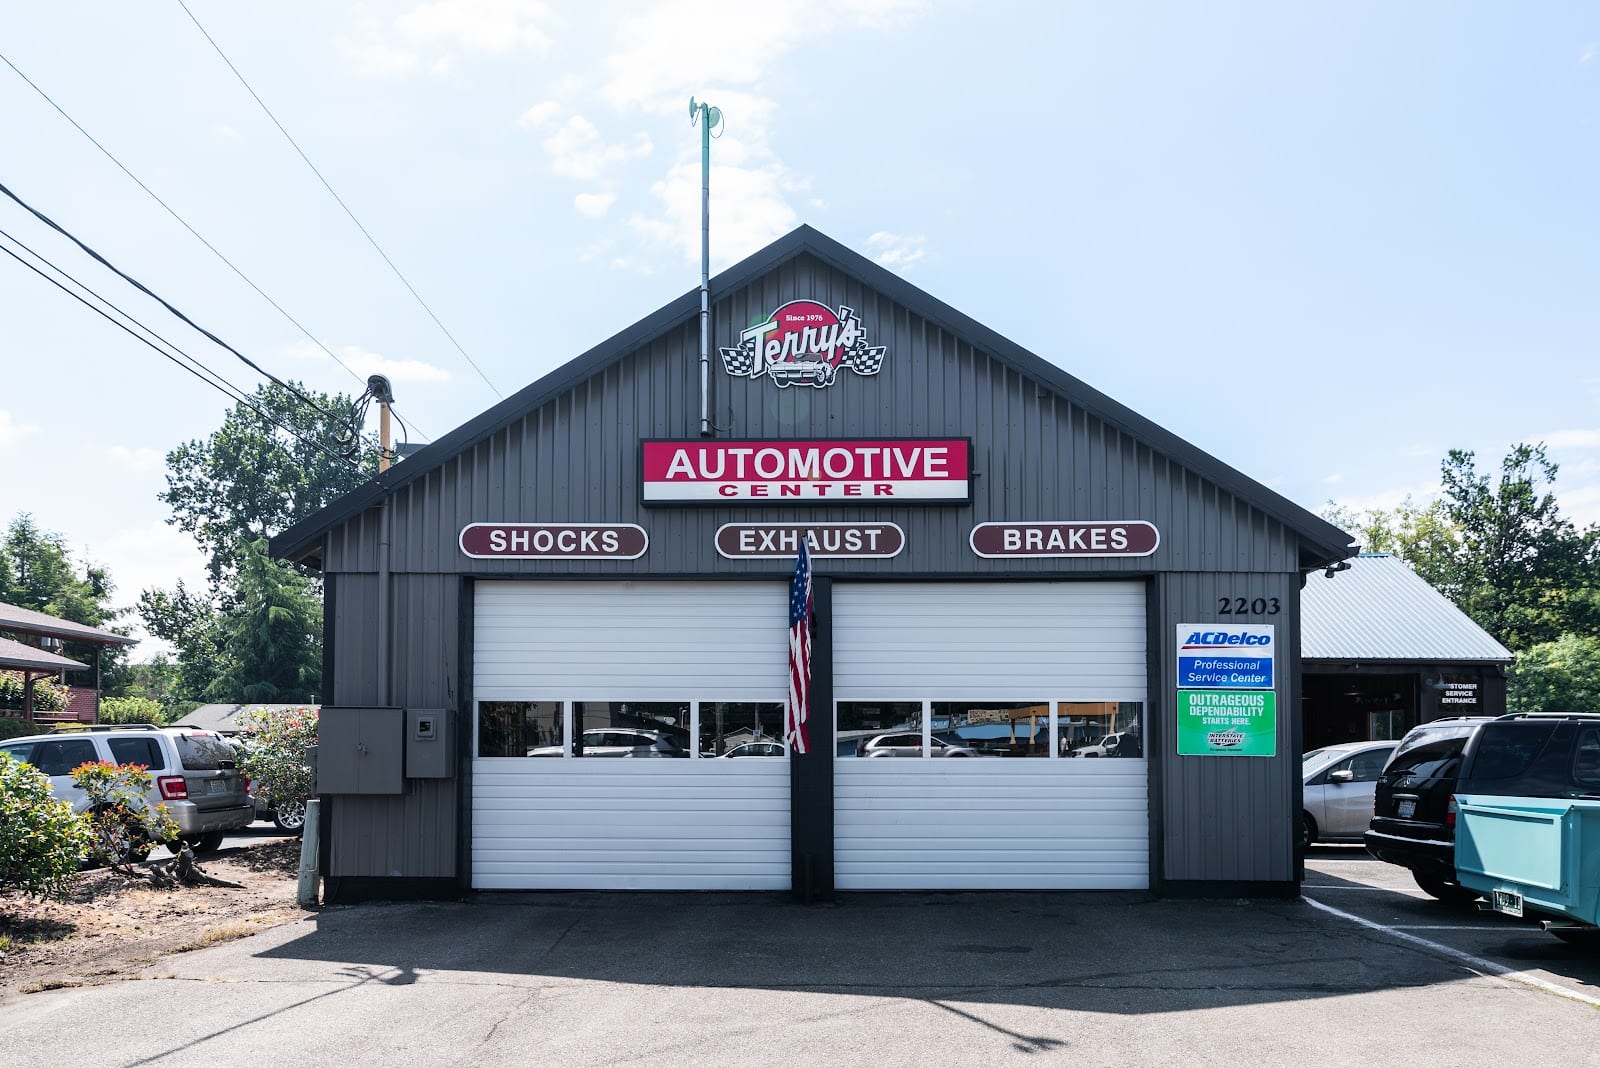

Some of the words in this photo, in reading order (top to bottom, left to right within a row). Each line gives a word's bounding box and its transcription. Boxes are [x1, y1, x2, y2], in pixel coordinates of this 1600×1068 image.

[785, 314, 805, 322] Since
[806, 314, 823, 322] 1976
[743, 308, 861, 374] Terry's
[665, 447, 949, 479] AUTOMOTIVE
[718, 483, 895, 497] CENTER
[489, 529, 619, 553] SHOCKS
[739, 529, 882, 551] EXHAUST
[1003, 527, 1129, 550] BRAKES
[1218, 597, 1281, 615] 2203
[1185, 632, 1271, 645] ACDelco
[1193, 660, 1260, 670] Professional
[1187, 672, 1228, 682] Service
[1230, 673, 1266, 683] Center
[1189, 694, 1264, 706] OUTRAGEOUS
[1189, 706, 1264, 717] DEPENDABILITY
[1202, 717, 1229, 725] STARTS
